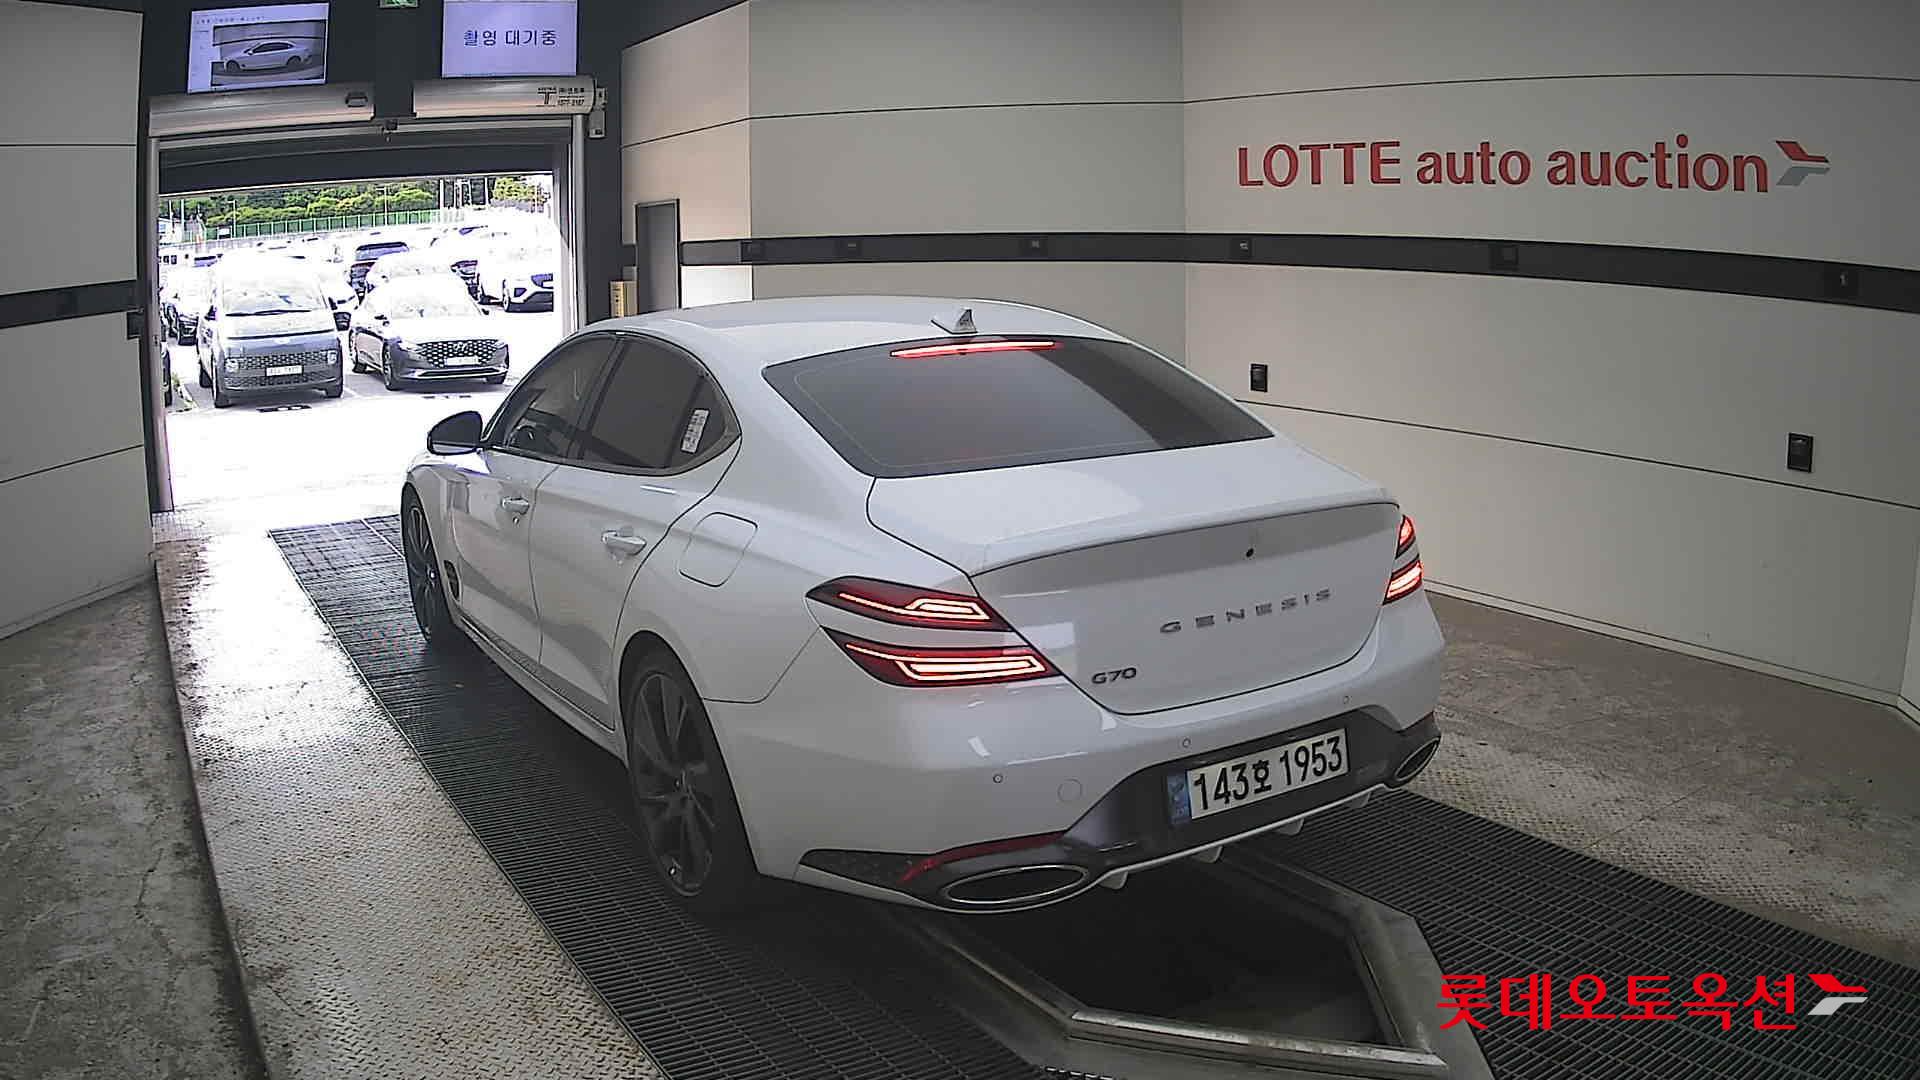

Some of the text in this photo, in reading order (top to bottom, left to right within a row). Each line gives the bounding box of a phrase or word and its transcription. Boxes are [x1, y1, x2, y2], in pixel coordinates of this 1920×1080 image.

[505, 30, 557, 46] 대기중
[1237, 134, 1768, 192] LOTTE auto auction
[1160, 589, 1330, 634] GENESIS
[1092, 667, 1137, 685] G70
[1193, 736, 1342, 811] 143호 1953
